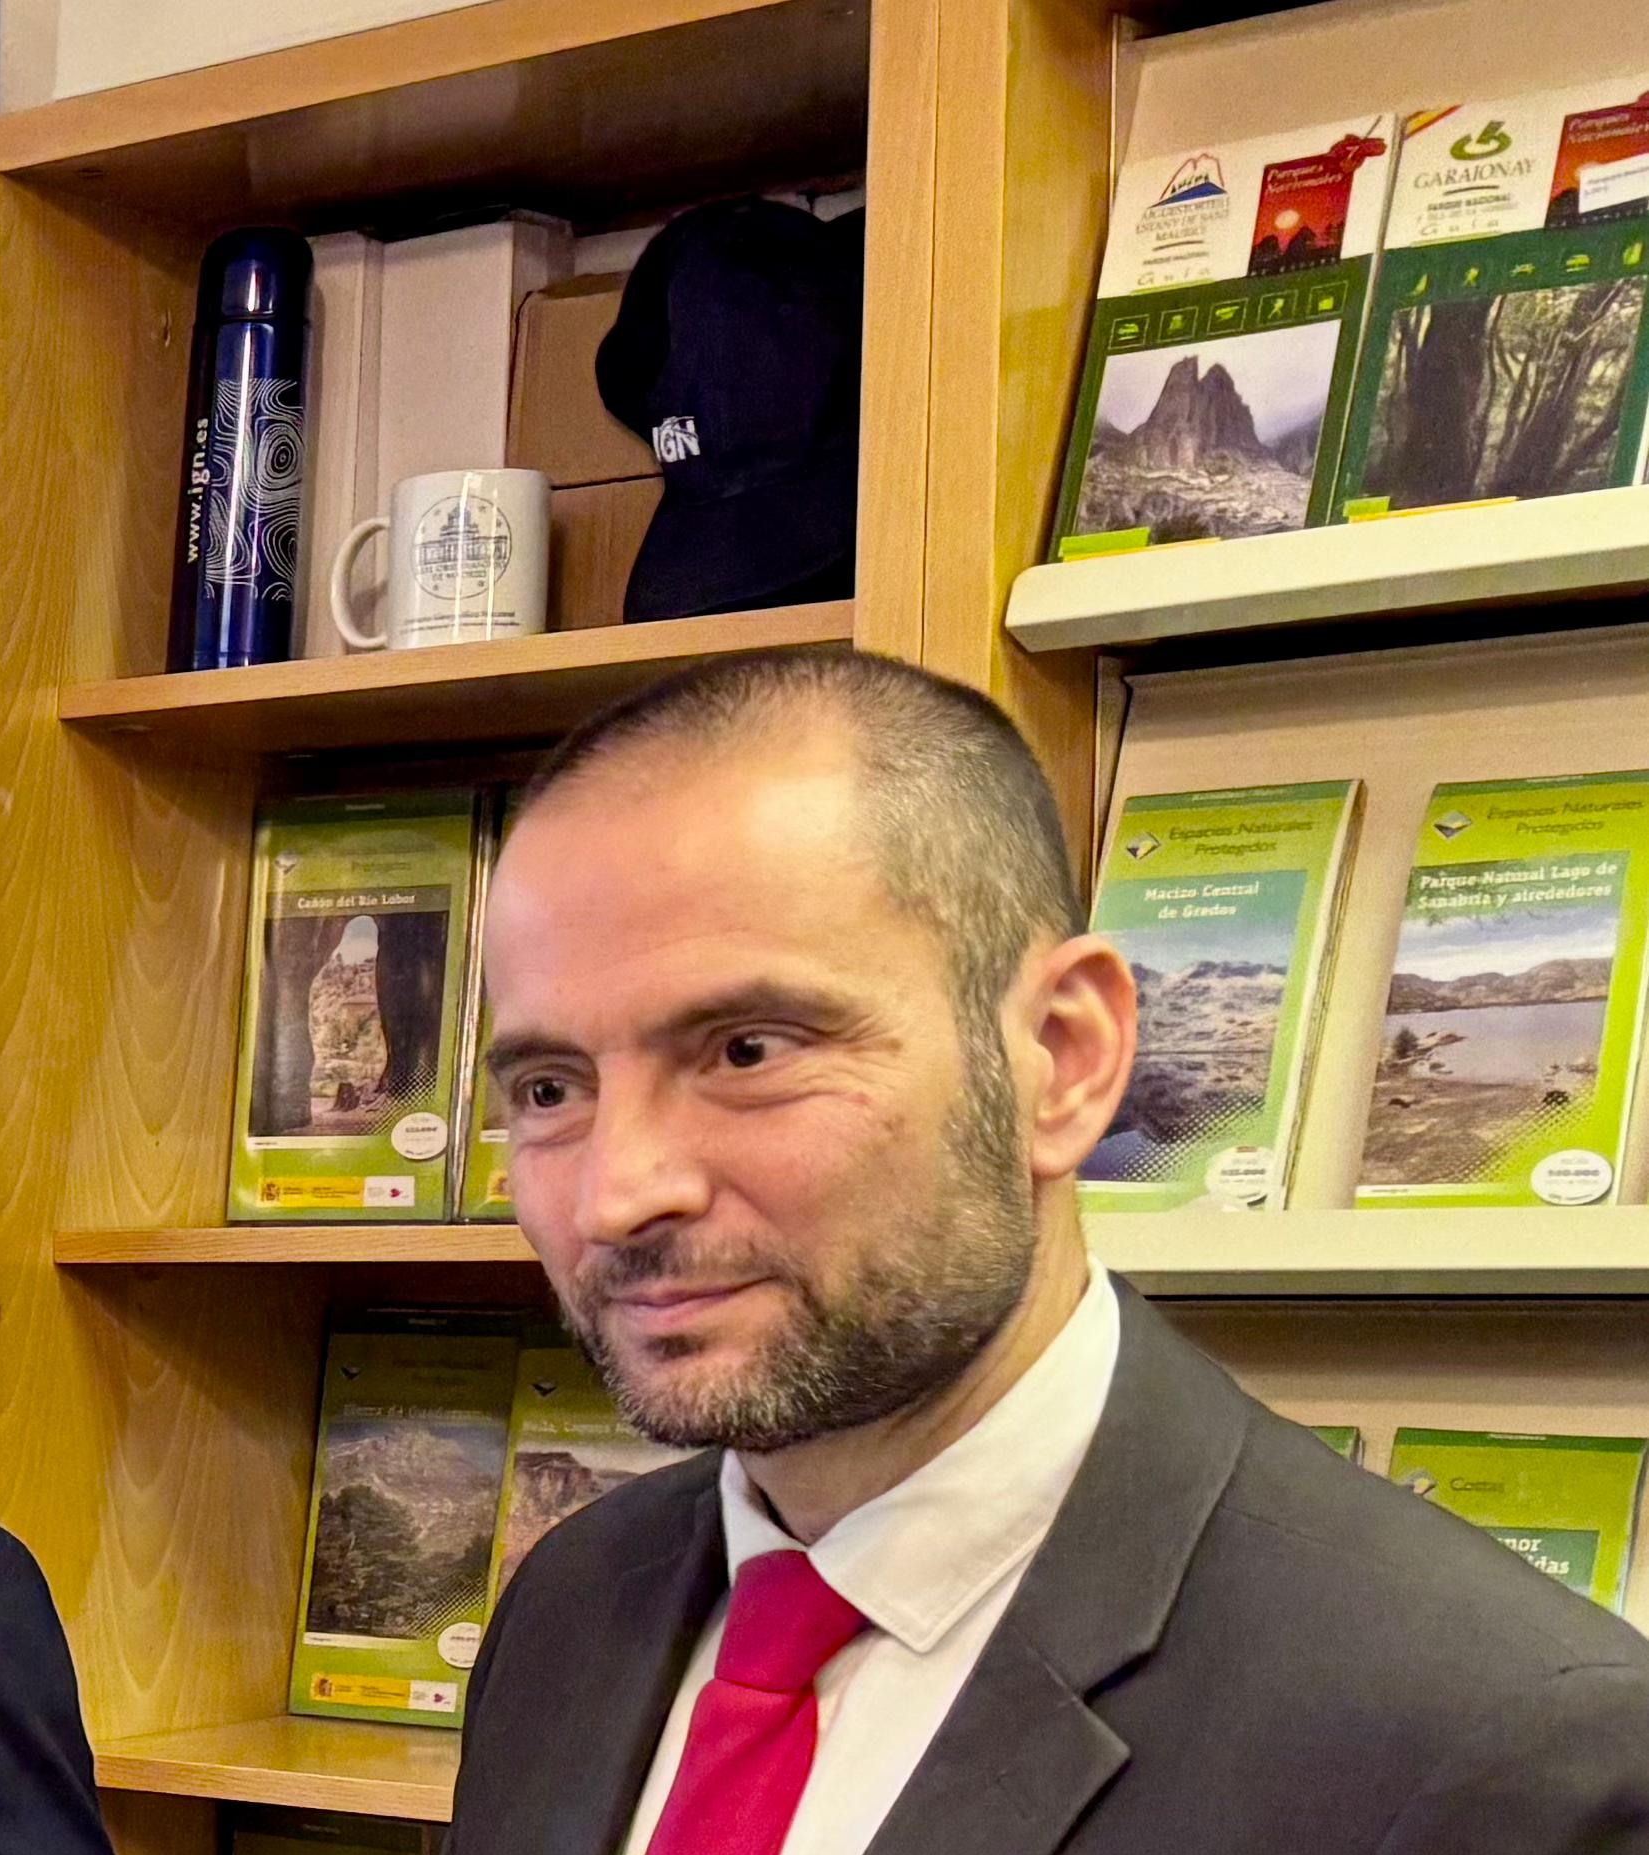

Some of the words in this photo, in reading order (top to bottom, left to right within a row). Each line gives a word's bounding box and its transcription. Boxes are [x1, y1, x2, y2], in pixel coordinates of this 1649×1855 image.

[652, 416, 701, 463] IGN
[187, 418, 210, 564] www.ign.es
[1420, 875, 1477, 891] Parque
[1481, 866, 1545, 884] Natural
[1550, 865, 1591, 881] Lago
[1595, 861, 1617, 875] de
[1144, 887, 1198, 901] Macizo
[1202, 880, 1260, 898] Central
[1417, 893, 1491, 910] Sanabria
[1496, 891, 1508, 907] y
[1158, 906, 1177, 920] de
[1182, 904, 1237, 919] Gredos
